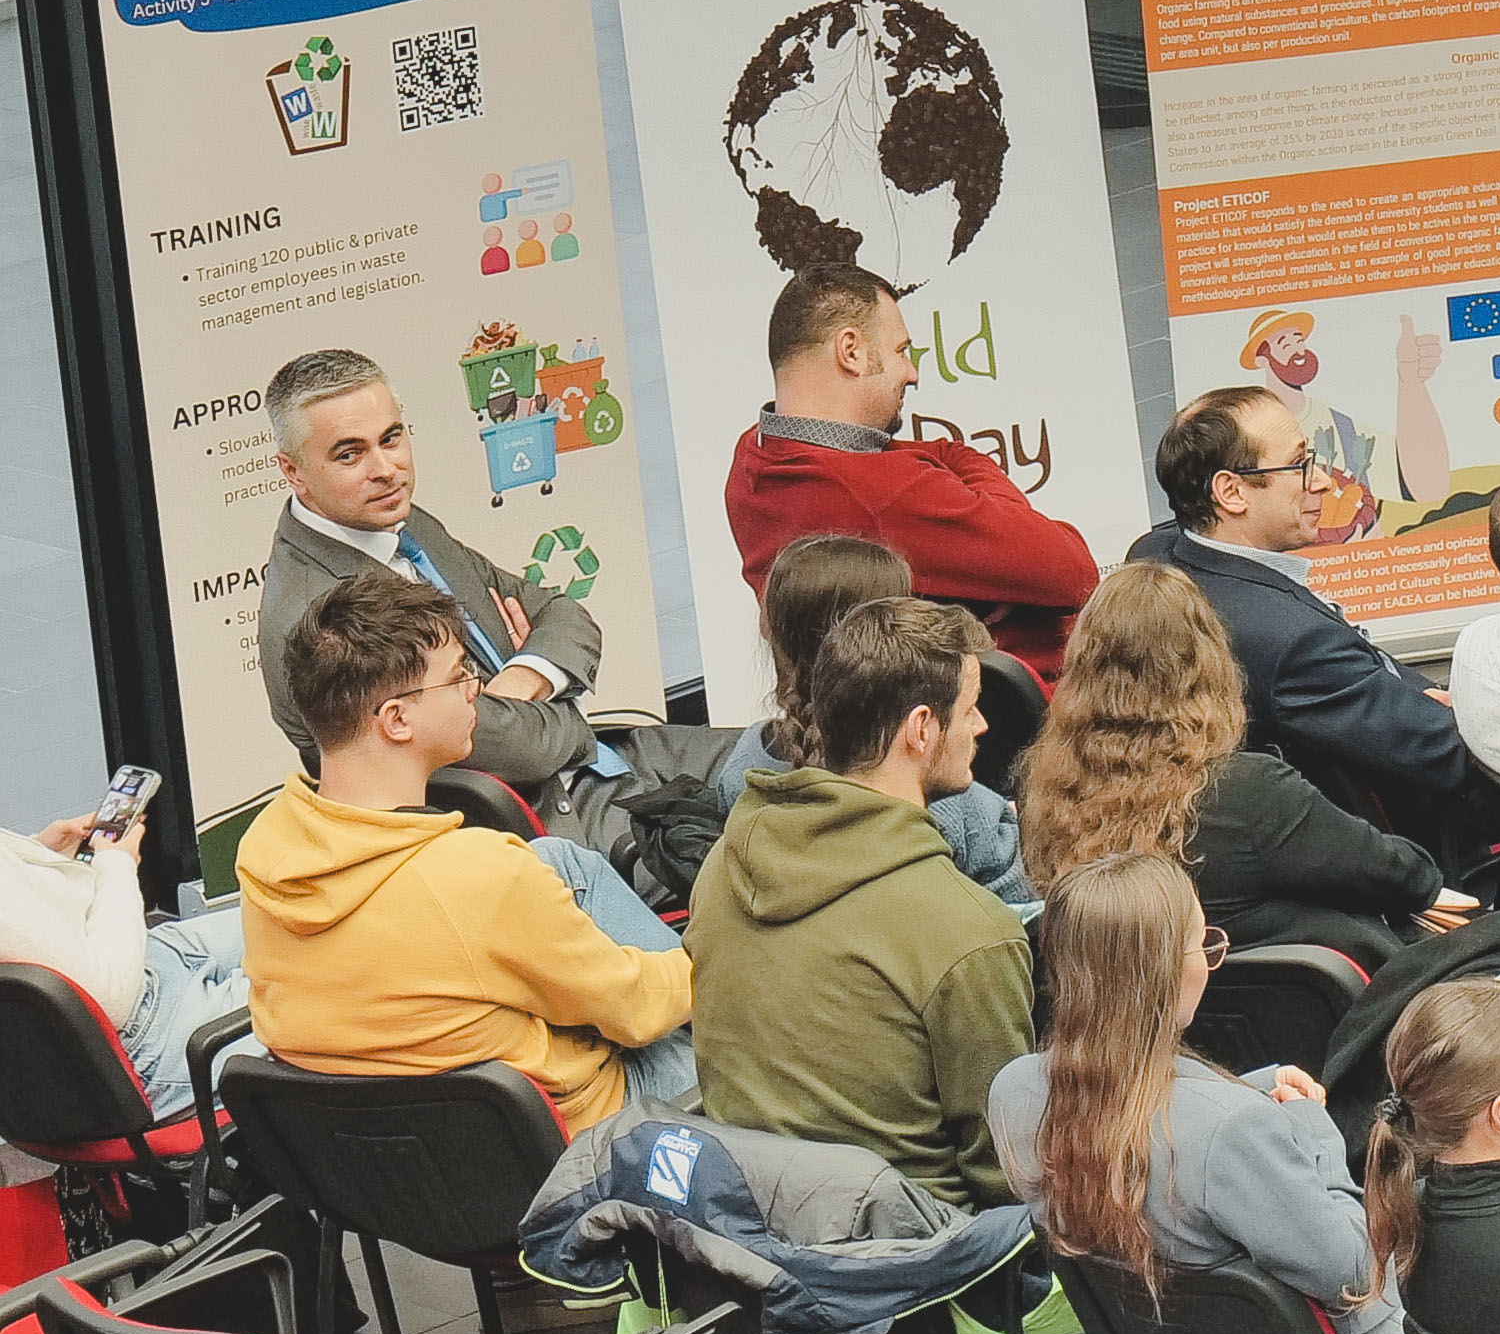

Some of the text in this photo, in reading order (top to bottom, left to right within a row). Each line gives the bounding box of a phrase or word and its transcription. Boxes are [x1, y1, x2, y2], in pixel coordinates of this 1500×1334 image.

[150, 207, 280, 253] TRAINING
[196, 224, 418, 281] Training 120 public & private
[198, 251, 405, 306] sector employees in waste
[202, 273, 424, 331] management and legislation.
